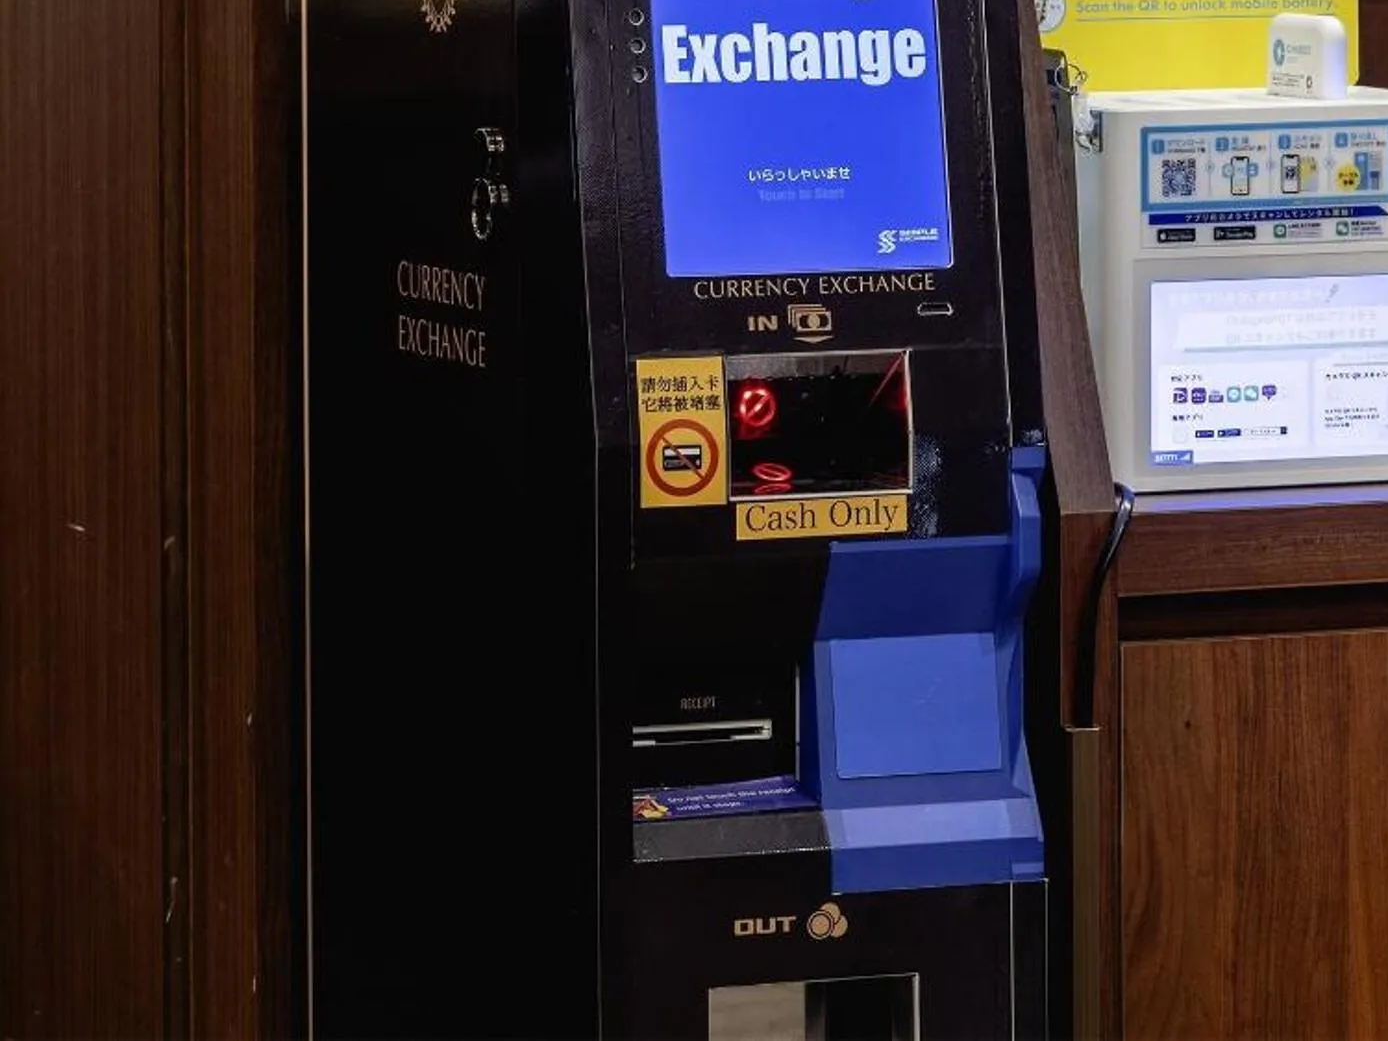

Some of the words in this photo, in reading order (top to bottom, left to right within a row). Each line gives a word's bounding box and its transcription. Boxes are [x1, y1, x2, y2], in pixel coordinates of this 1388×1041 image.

[1076, 0, 1108, 13] Scan
[1113, 0, 1133, 12] the
[1163, 0, 1177, 11] to
[661, 23, 927, 86] Exchange
[748, 166, 851, 183] いらっしゃいませ
[758, 189, 796, 202] Touch
[814, 188, 846, 200] Start
[399, 260, 487, 312] CURRENCY
[694, 277, 810, 300] CURRENCY
[819, 272, 936, 294] EXCHANGE
[748, 315, 779, 332] IN
[399, 315, 487, 368] EXCHANGE
[745, 502, 816, 533] Cash
[829, 498, 899, 530] Only
[680, 695, 717, 710] RECEIPT
[734, 915, 797, 936] OUT
